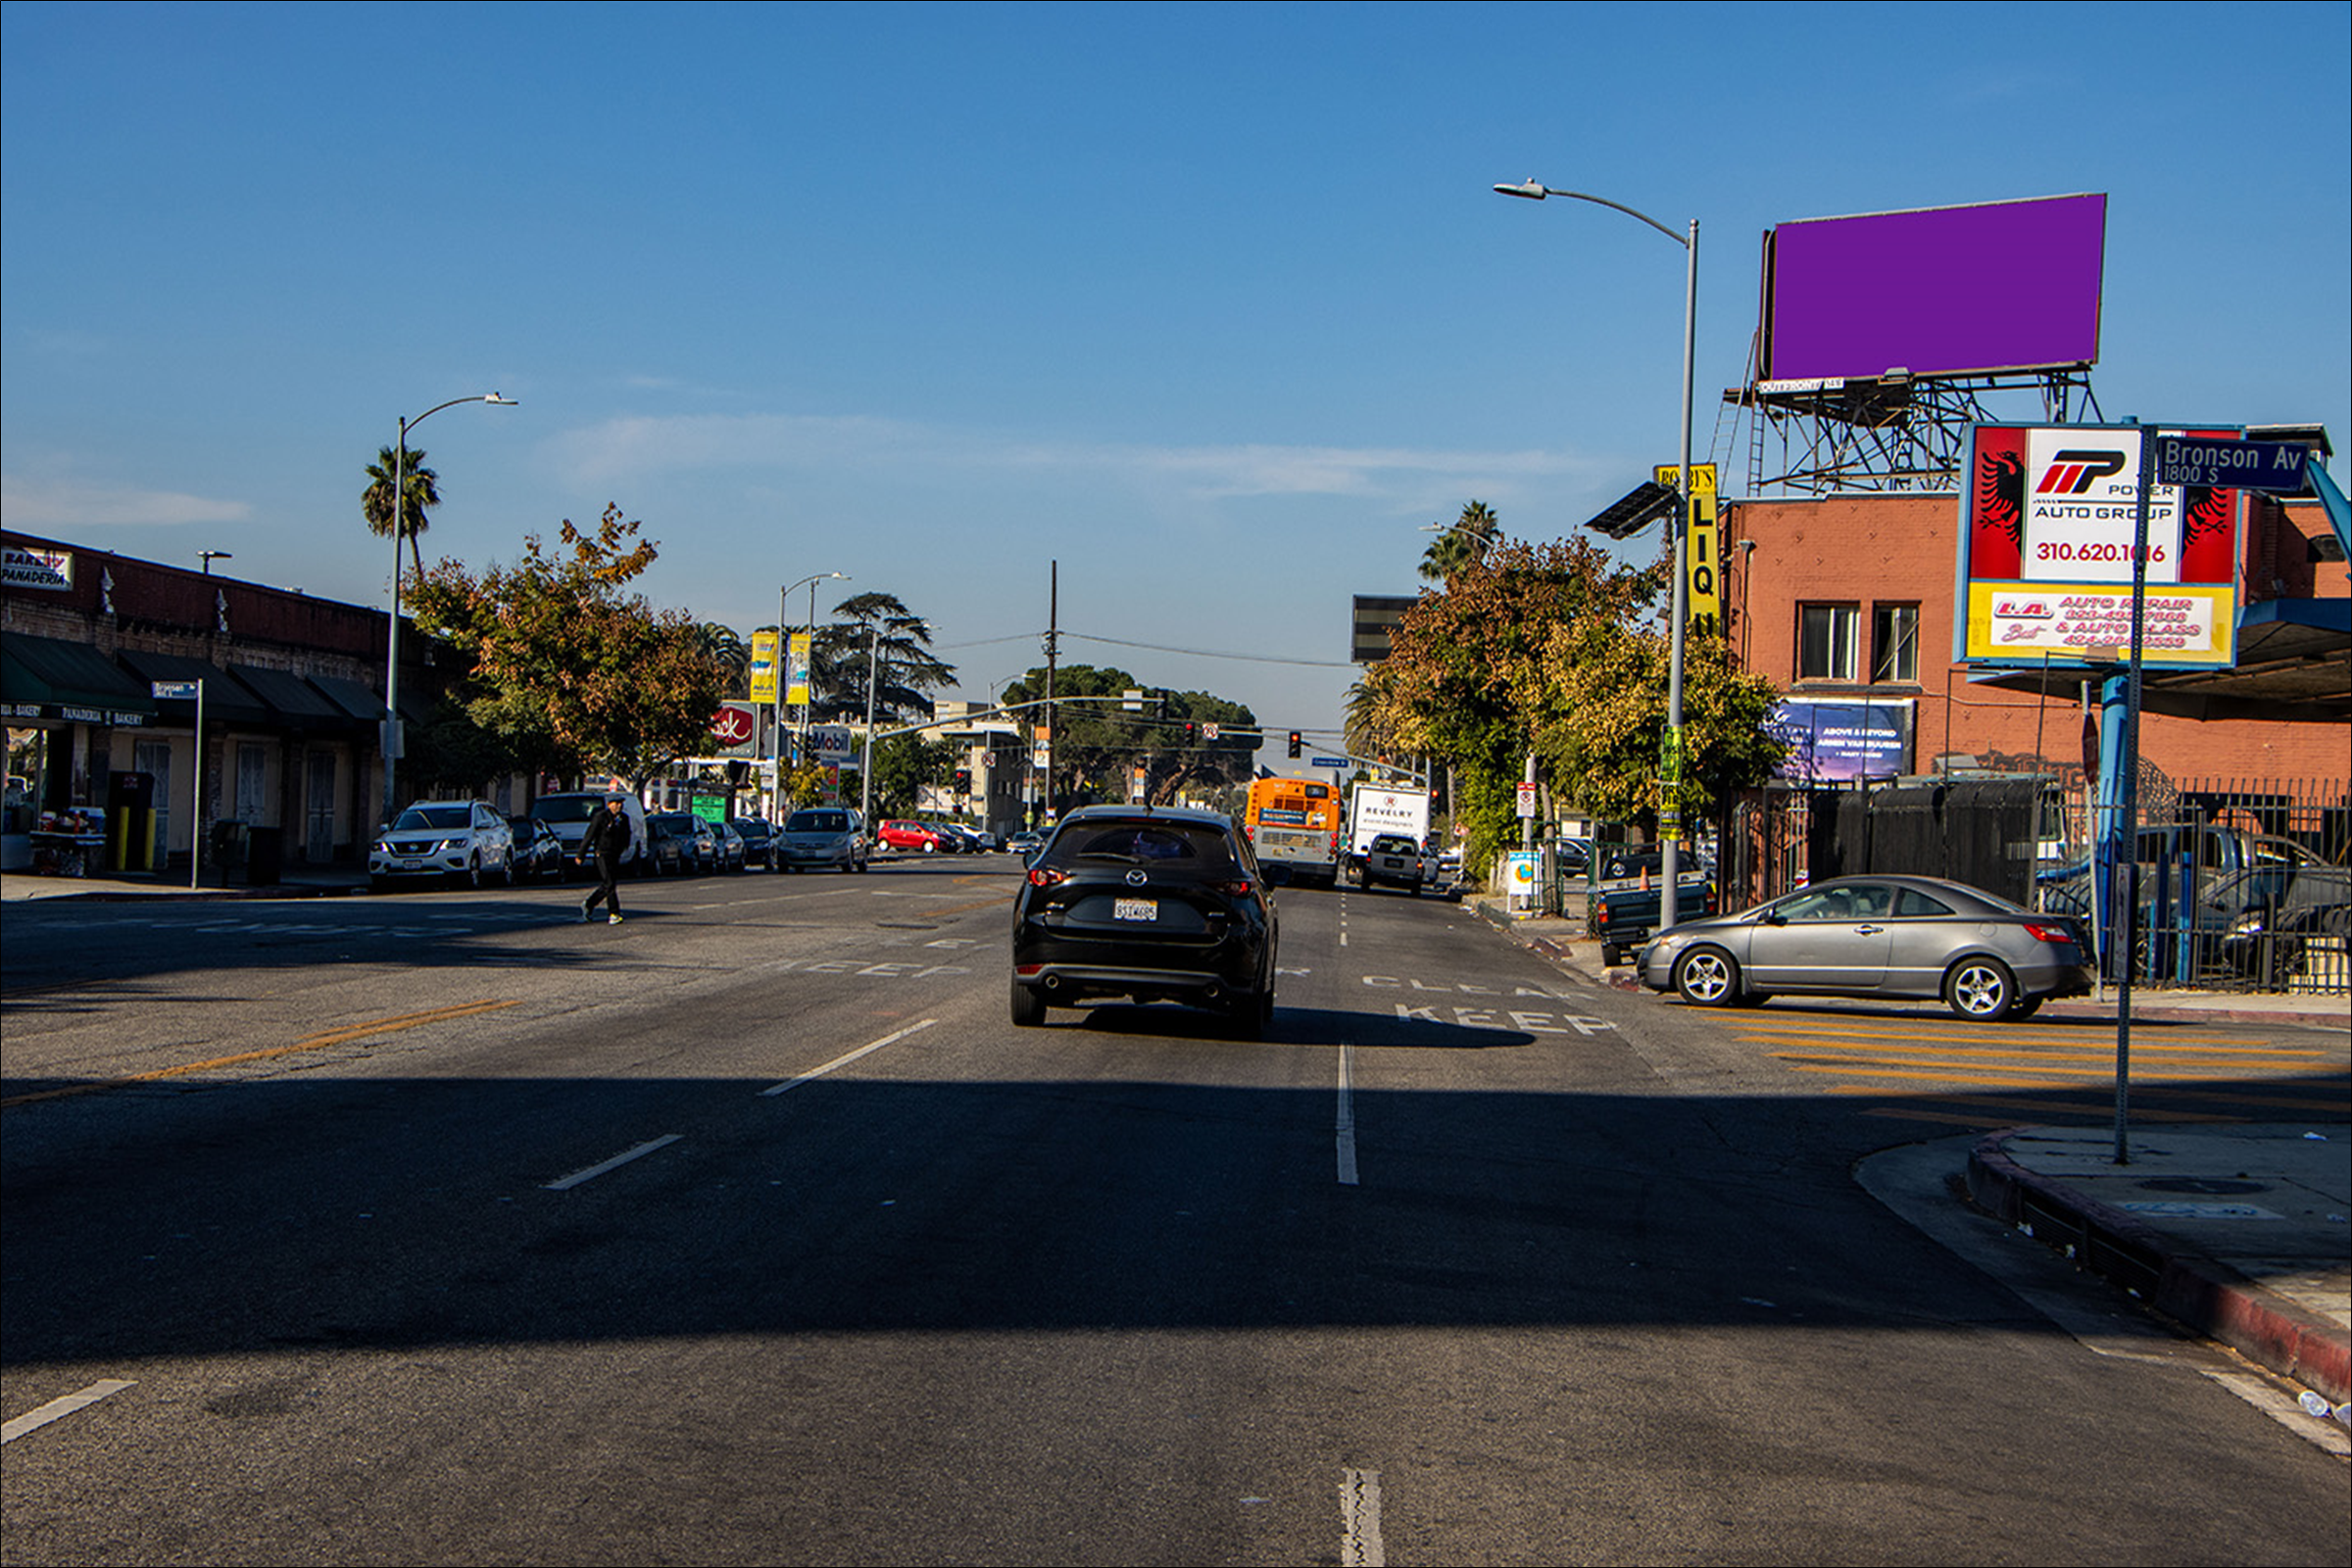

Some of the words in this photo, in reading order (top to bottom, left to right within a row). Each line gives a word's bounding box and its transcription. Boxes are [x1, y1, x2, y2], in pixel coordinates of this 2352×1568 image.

[2165, 441, 2259, 468] Bronson
[2273, 446, 2301, 470] Av
[1662, 469, 1713, 487] BOBY'S
[2164, 465, 2201, 482] 1800
[2207, 467, 2219, 483] S
[2108, 485, 2175, 496] POER
[2034, 507, 2091, 518] AUTO
[2095, 508, 2173, 520] GROUP
[2, 569, 65, 586] PANADERIA
[1996, 601, 2052, 617] L.A.
[2059, 596, 2116, 609] AUTO
[2119, 597, 2193, 612] RPAIR
[2064, 609, 2188, 623] 323-497868
[2055, 620, 2070, 633] &
[2072, 621, 2130, 634] AUTO
[2063, 634, 2186, 648] 424-2042559
[710, 710, 752, 740] ack
[813, 730, 849, 752] Mobil
[1365, 807, 1413, 818] REVELRY
[1394, 1004, 1619, 1036] KEEP
